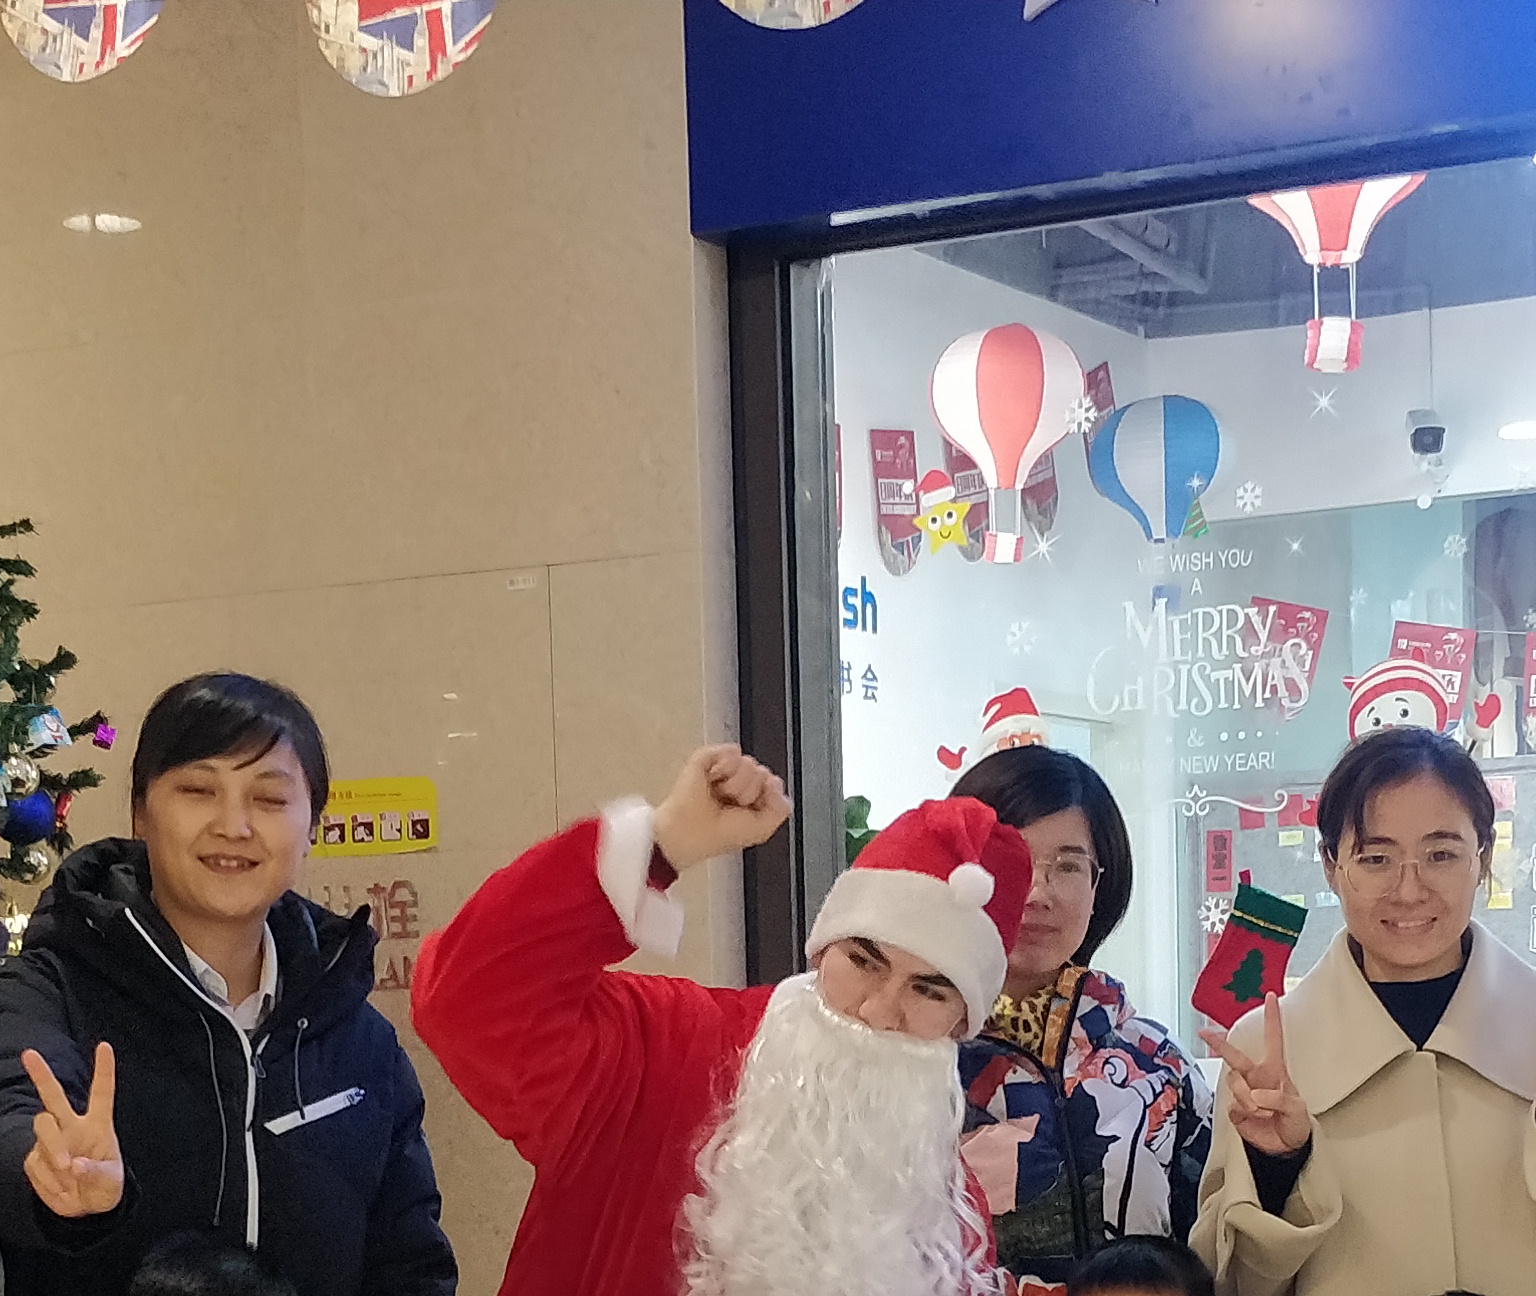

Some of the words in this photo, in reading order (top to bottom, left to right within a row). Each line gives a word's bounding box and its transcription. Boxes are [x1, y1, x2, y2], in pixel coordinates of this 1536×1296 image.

[1170, 552, 1213, 573] WISH
[1218, 548, 1253, 569] YOU
[1190, 577, 1203, 596] A
[1123, 597, 1277, 664] MERRY
[1087, 638, 1311, 718] CHRISTMAS
[1186, 728, 1205, 748] &
[1179, 755, 1219, 774] NEW
[1224, 751, 1275, 772] YEAR!
